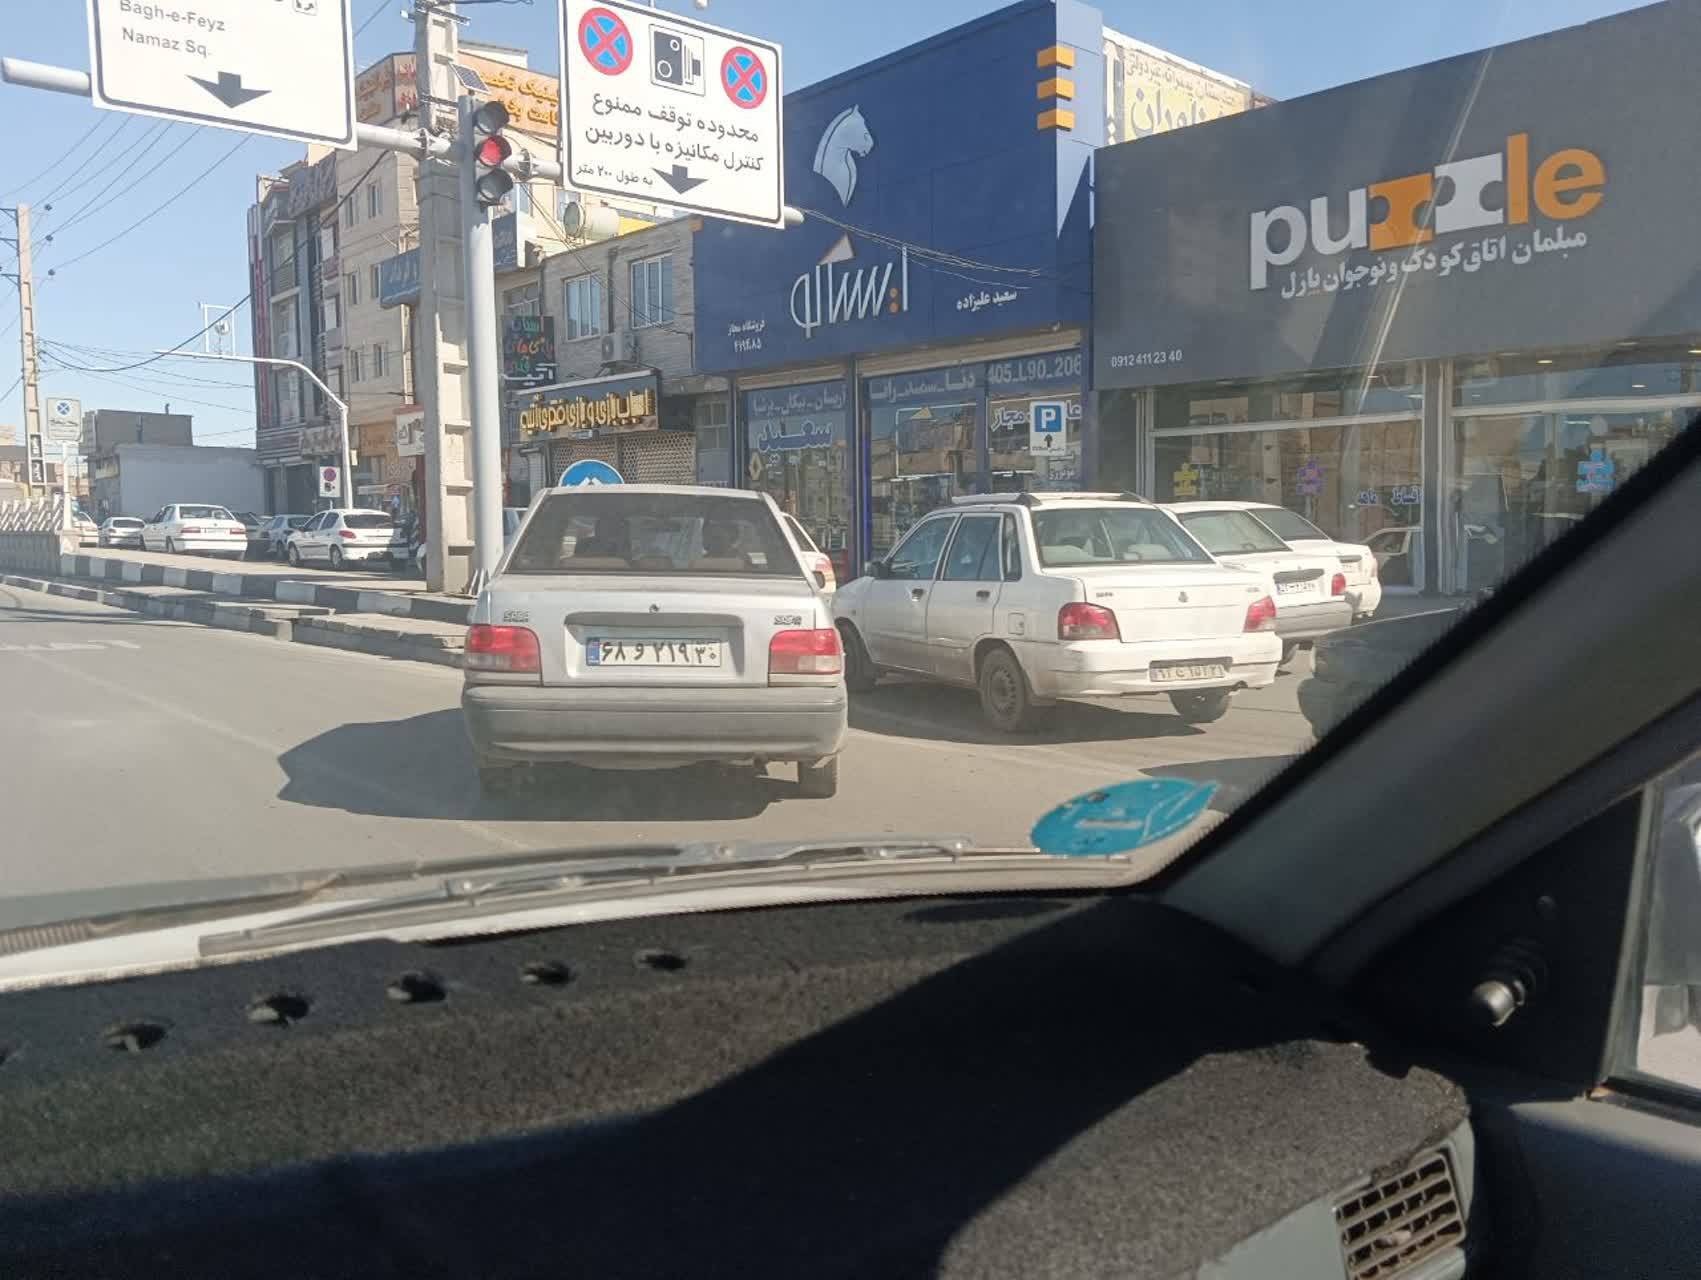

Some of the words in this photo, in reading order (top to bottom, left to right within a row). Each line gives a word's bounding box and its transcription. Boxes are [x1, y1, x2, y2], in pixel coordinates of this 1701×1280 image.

[120, 0, 225, 32] Bagh-e-Feyz
[122, 27, 180, 50] Namaz
[592, 93, 642, 115] ممنوع
[647, 105, 692, 131] توقف
[585, 127, 645, 150] دوربین
[697, 119, 759, 142] محدوده
[650, 133, 660, 154] با
[665, 140, 720, 163] مکانیزه
[576, 164, 593, 176] متر
[724, 151, 764, 172] کنترل
[616, 169, 639, 185] طول
[643, 176, 653, 186] به
[1463, 234, 1506, 272] اتاق
[1512, 224, 1587, 264] مبلمان
[1400, 242, 1463, 276] کودک
[1322, 256, 1386, 292] نوجوان
[956, 291, 991, 312] علیزاده
[992, 290, 1017, 306] سعید
[1041, 408, 1056, 429] P
[602, 641, 626, 662] ۶۸
[634, 642, 645, 661] و
[653, 641, 690, 663] ۲۱۹
[695, 646, 717, 664] ۳۰
